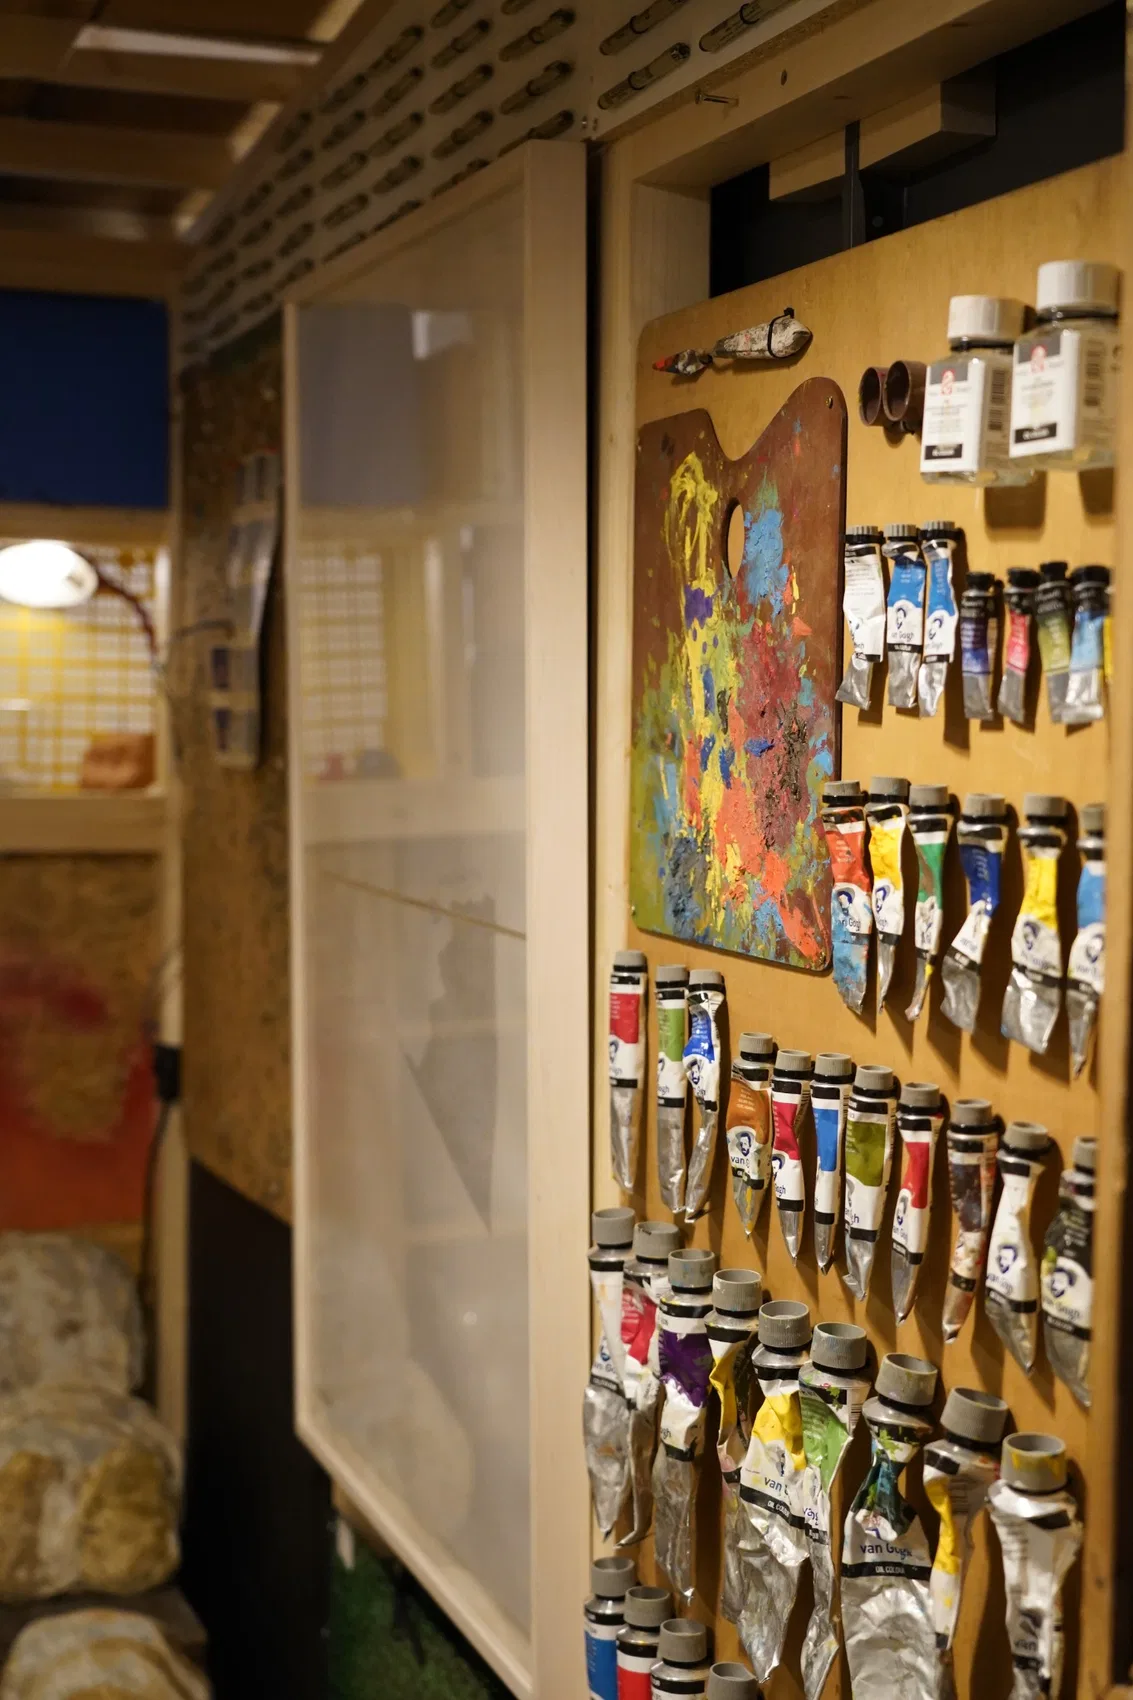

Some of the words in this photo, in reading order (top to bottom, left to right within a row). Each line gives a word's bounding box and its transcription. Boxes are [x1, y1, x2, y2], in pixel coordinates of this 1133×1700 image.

[731, 1155, 745, 1164] van
[764, 1476, 782, 1492] van
[860, 1543, 882, 1554] van
